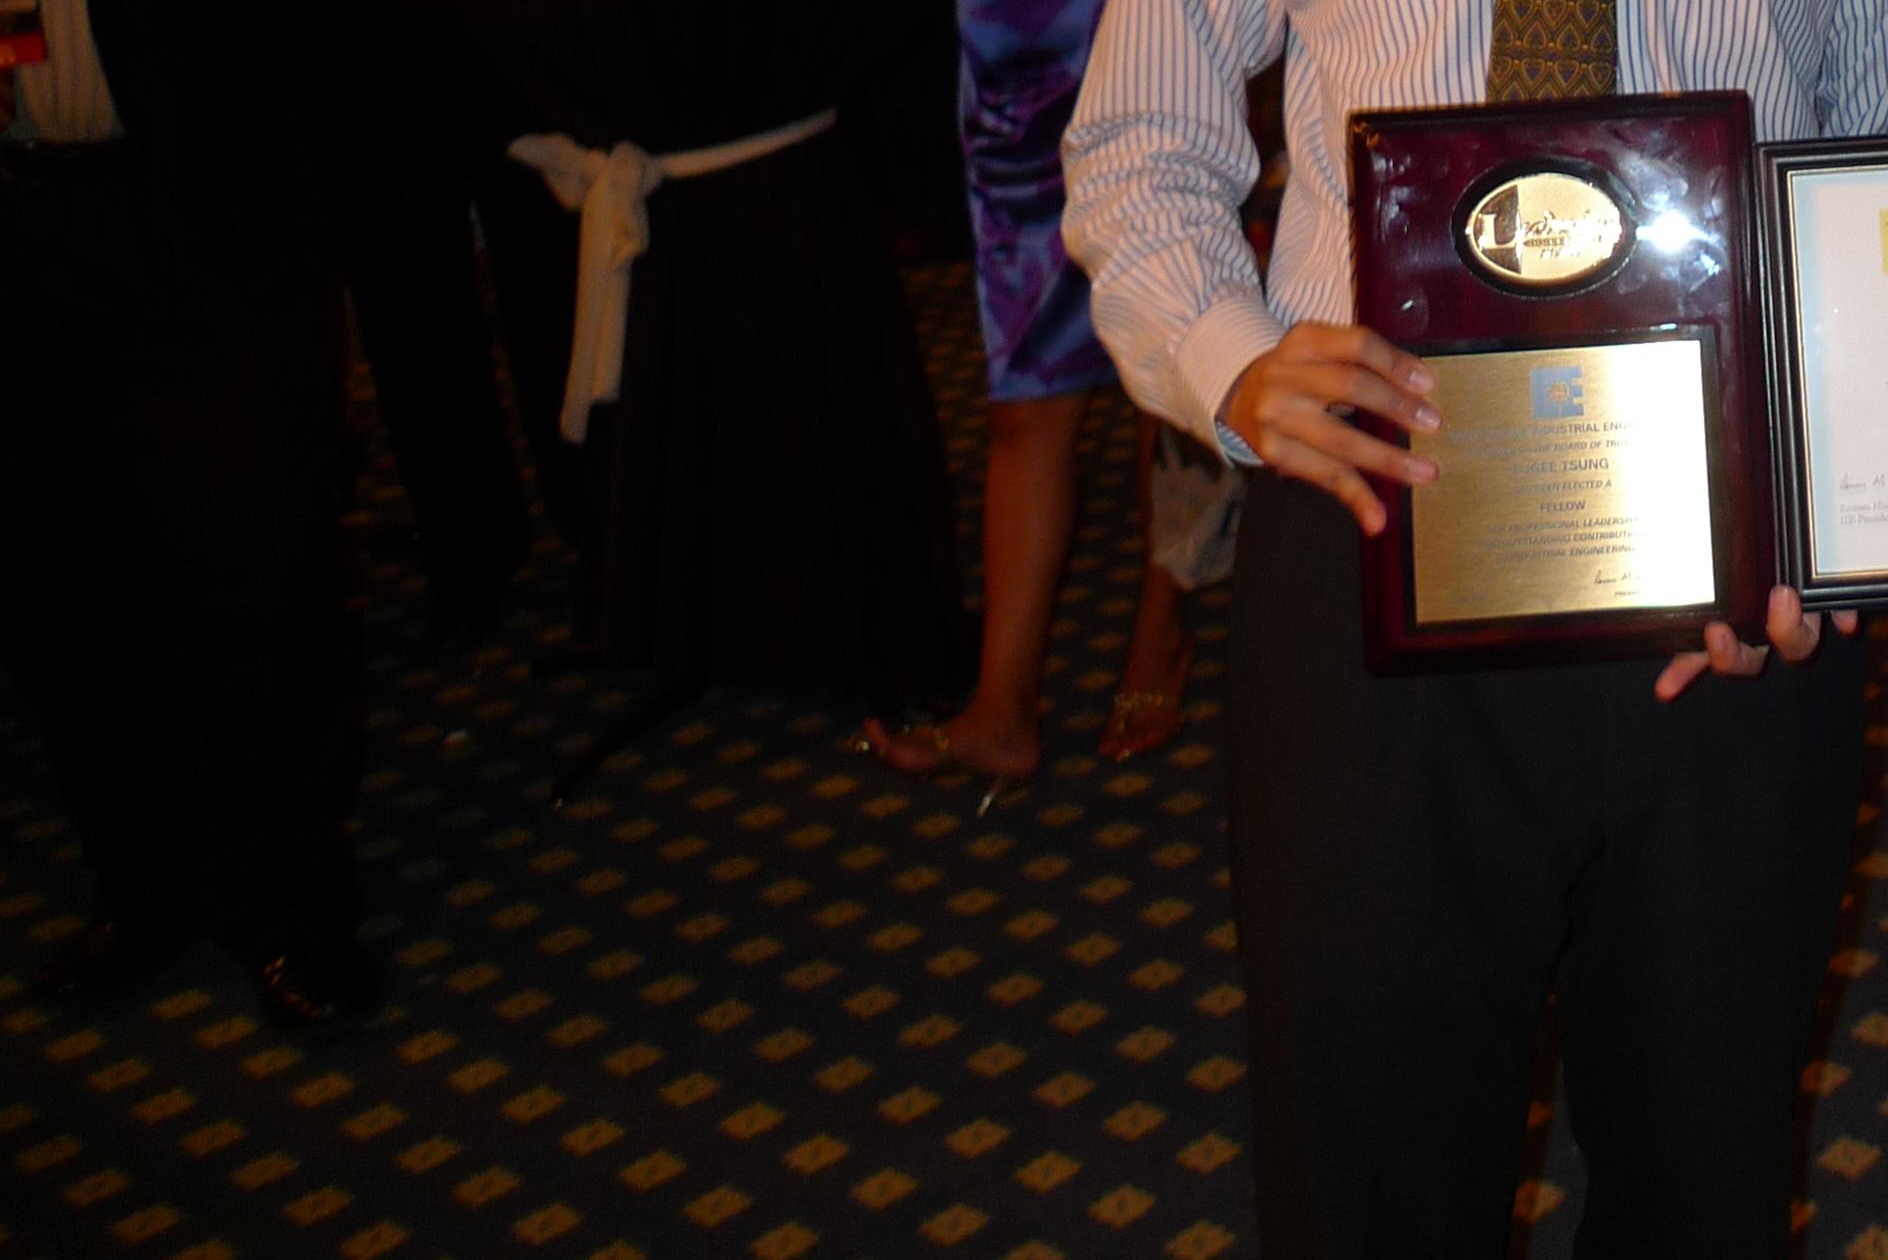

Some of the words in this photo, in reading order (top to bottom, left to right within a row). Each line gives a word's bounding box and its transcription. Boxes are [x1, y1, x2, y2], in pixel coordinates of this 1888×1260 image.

[1589, 440, 1602, 449] OF
[1562, 458, 1609, 472] TSUNG
[1561, 480, 1603, 491] ELECTED
[1604, 479, 1612, 488] A
[1540, 500, 1586, 513] FELLOW
